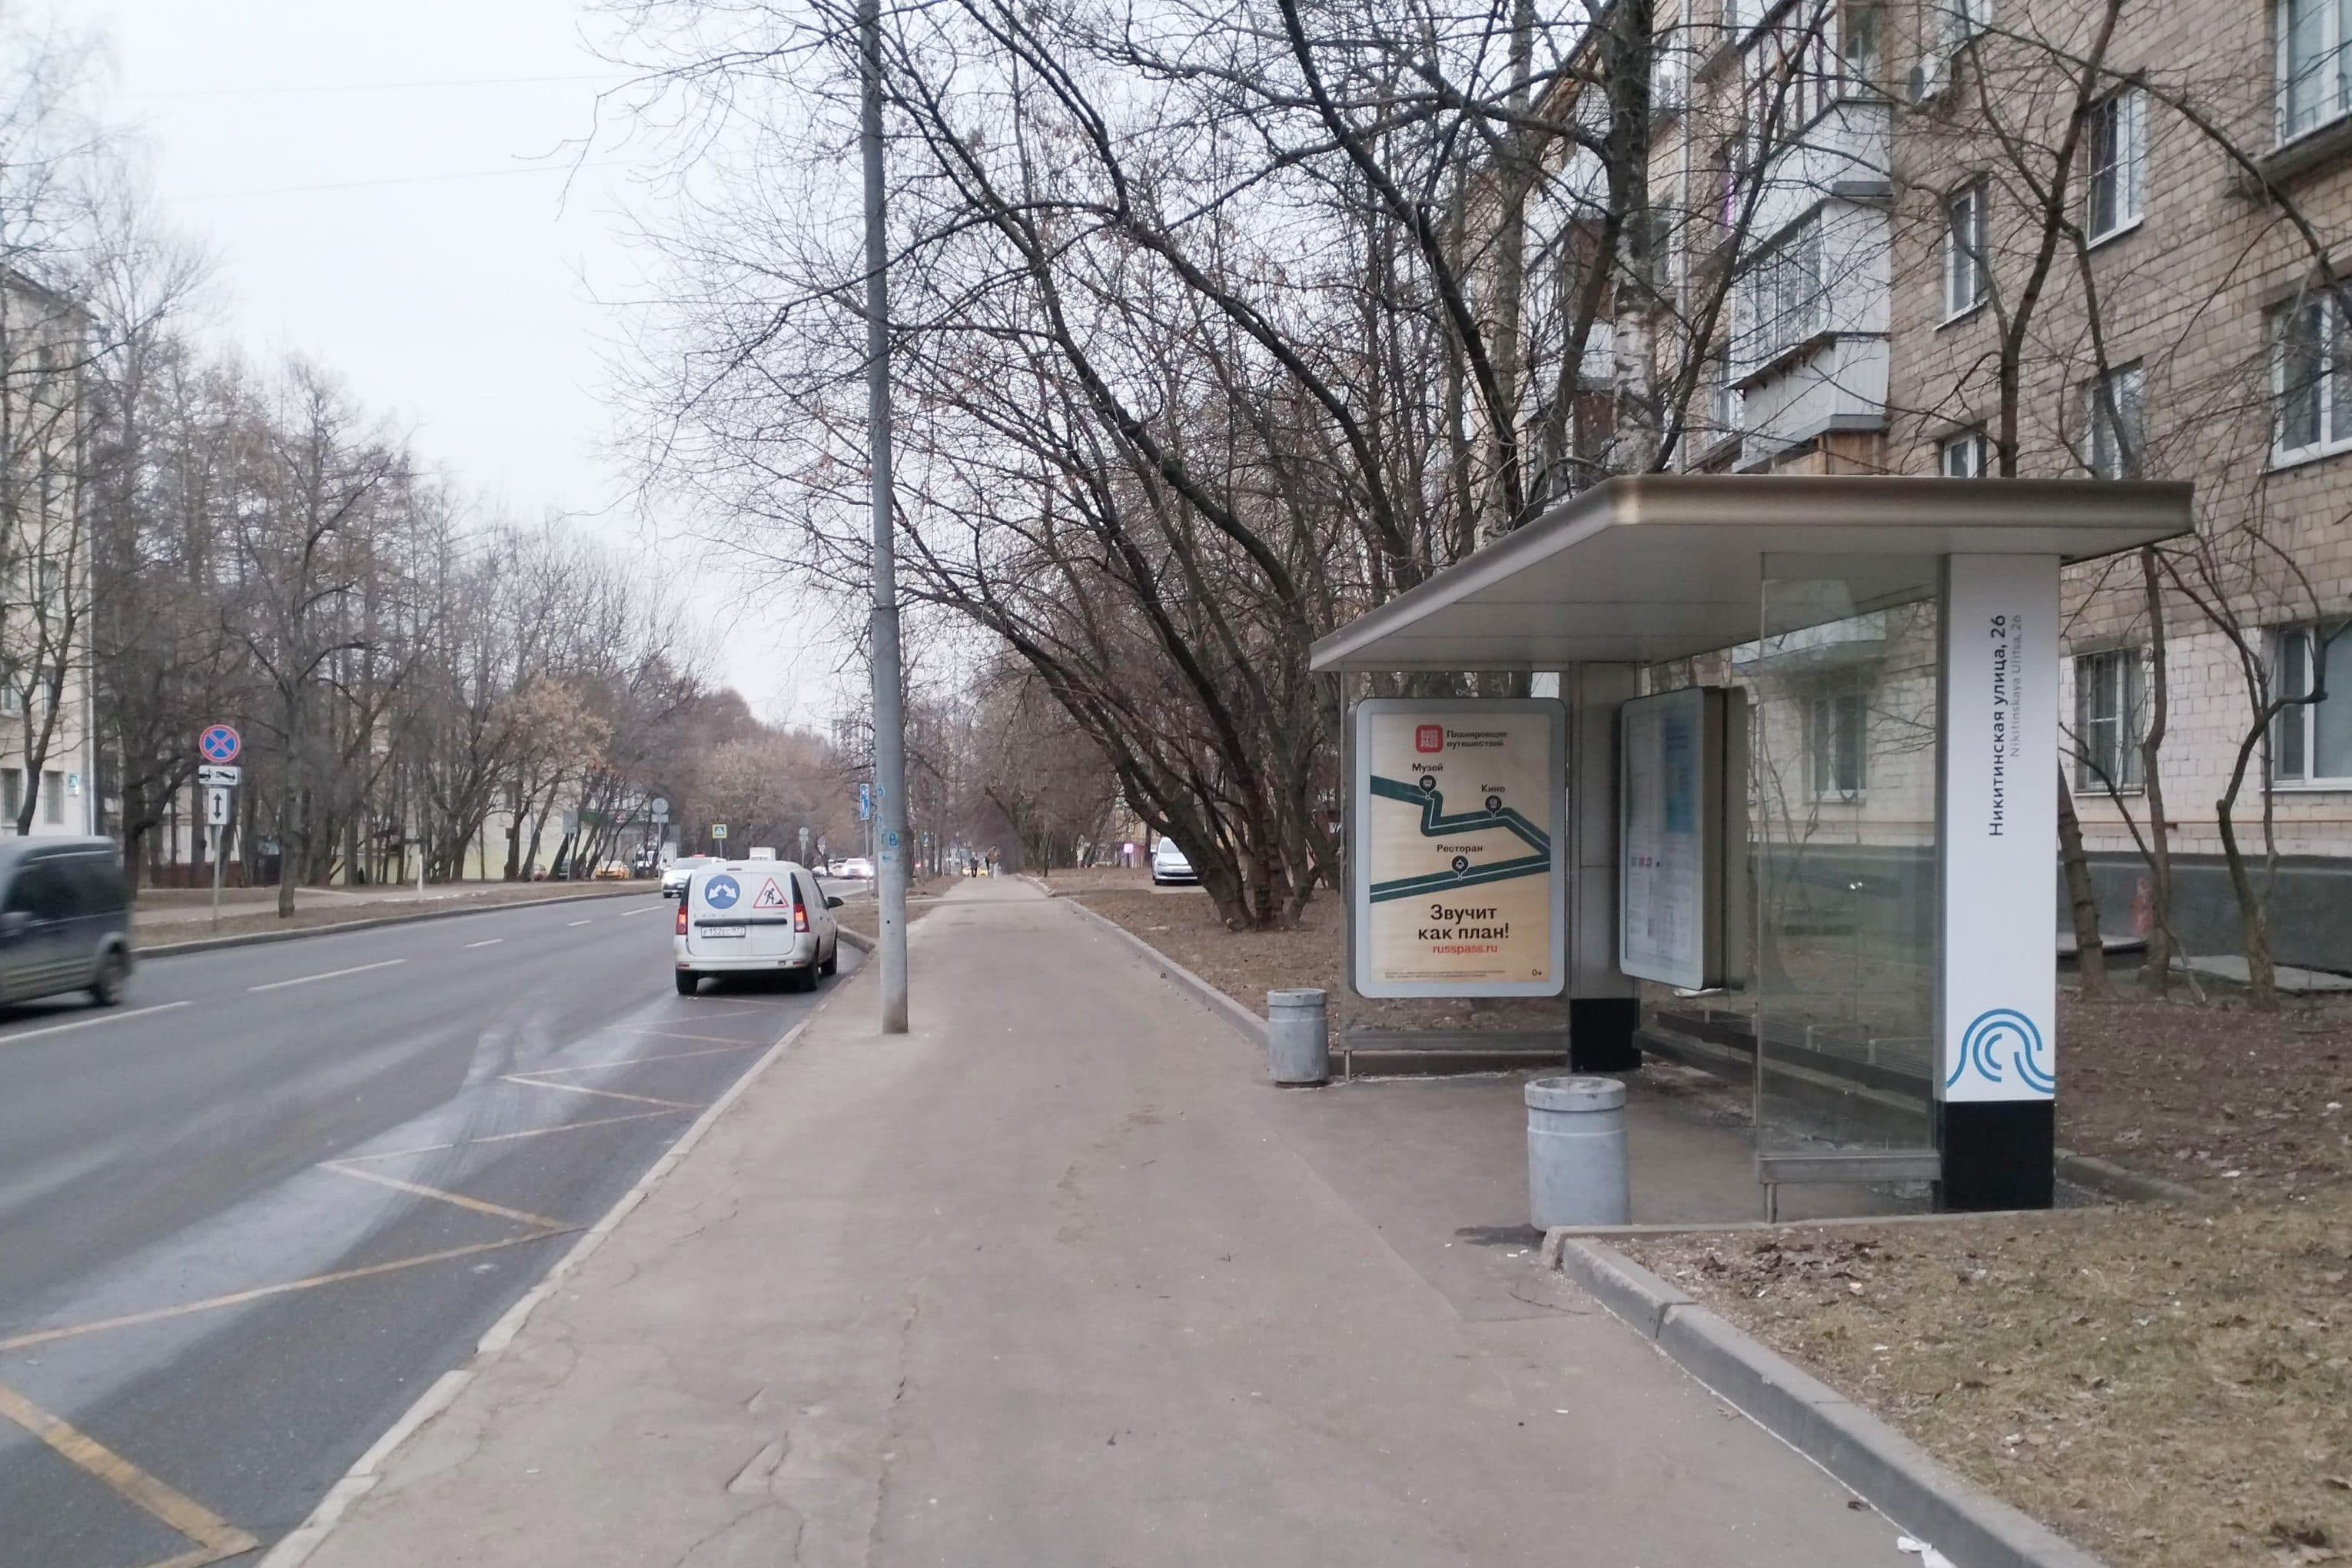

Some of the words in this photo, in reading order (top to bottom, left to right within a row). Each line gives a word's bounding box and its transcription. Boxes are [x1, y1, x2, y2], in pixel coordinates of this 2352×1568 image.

[1991, 615, 2005, 638] 26
[2011, 615, 2021, 630] 26
[1994, 644, 2008, 706] улица,
[2009, 678, 2021, 757] Nikitinskaya
[1412, 762, 1443, 774] Музей
[1989, 712, 2004, 835] Никитинская
[1480, 784, 1506, 792] Кино
[1437, 844, 1483, 854] Ресторан
[1430, 904, 1497, 925] Звучит
[1418, 928, 1453, 940] как
[1458, 922, 1509, 939] план!
[1433, 945, 1498, 955] russpass.ru
[1531, 968, 1543, 977] 0+
